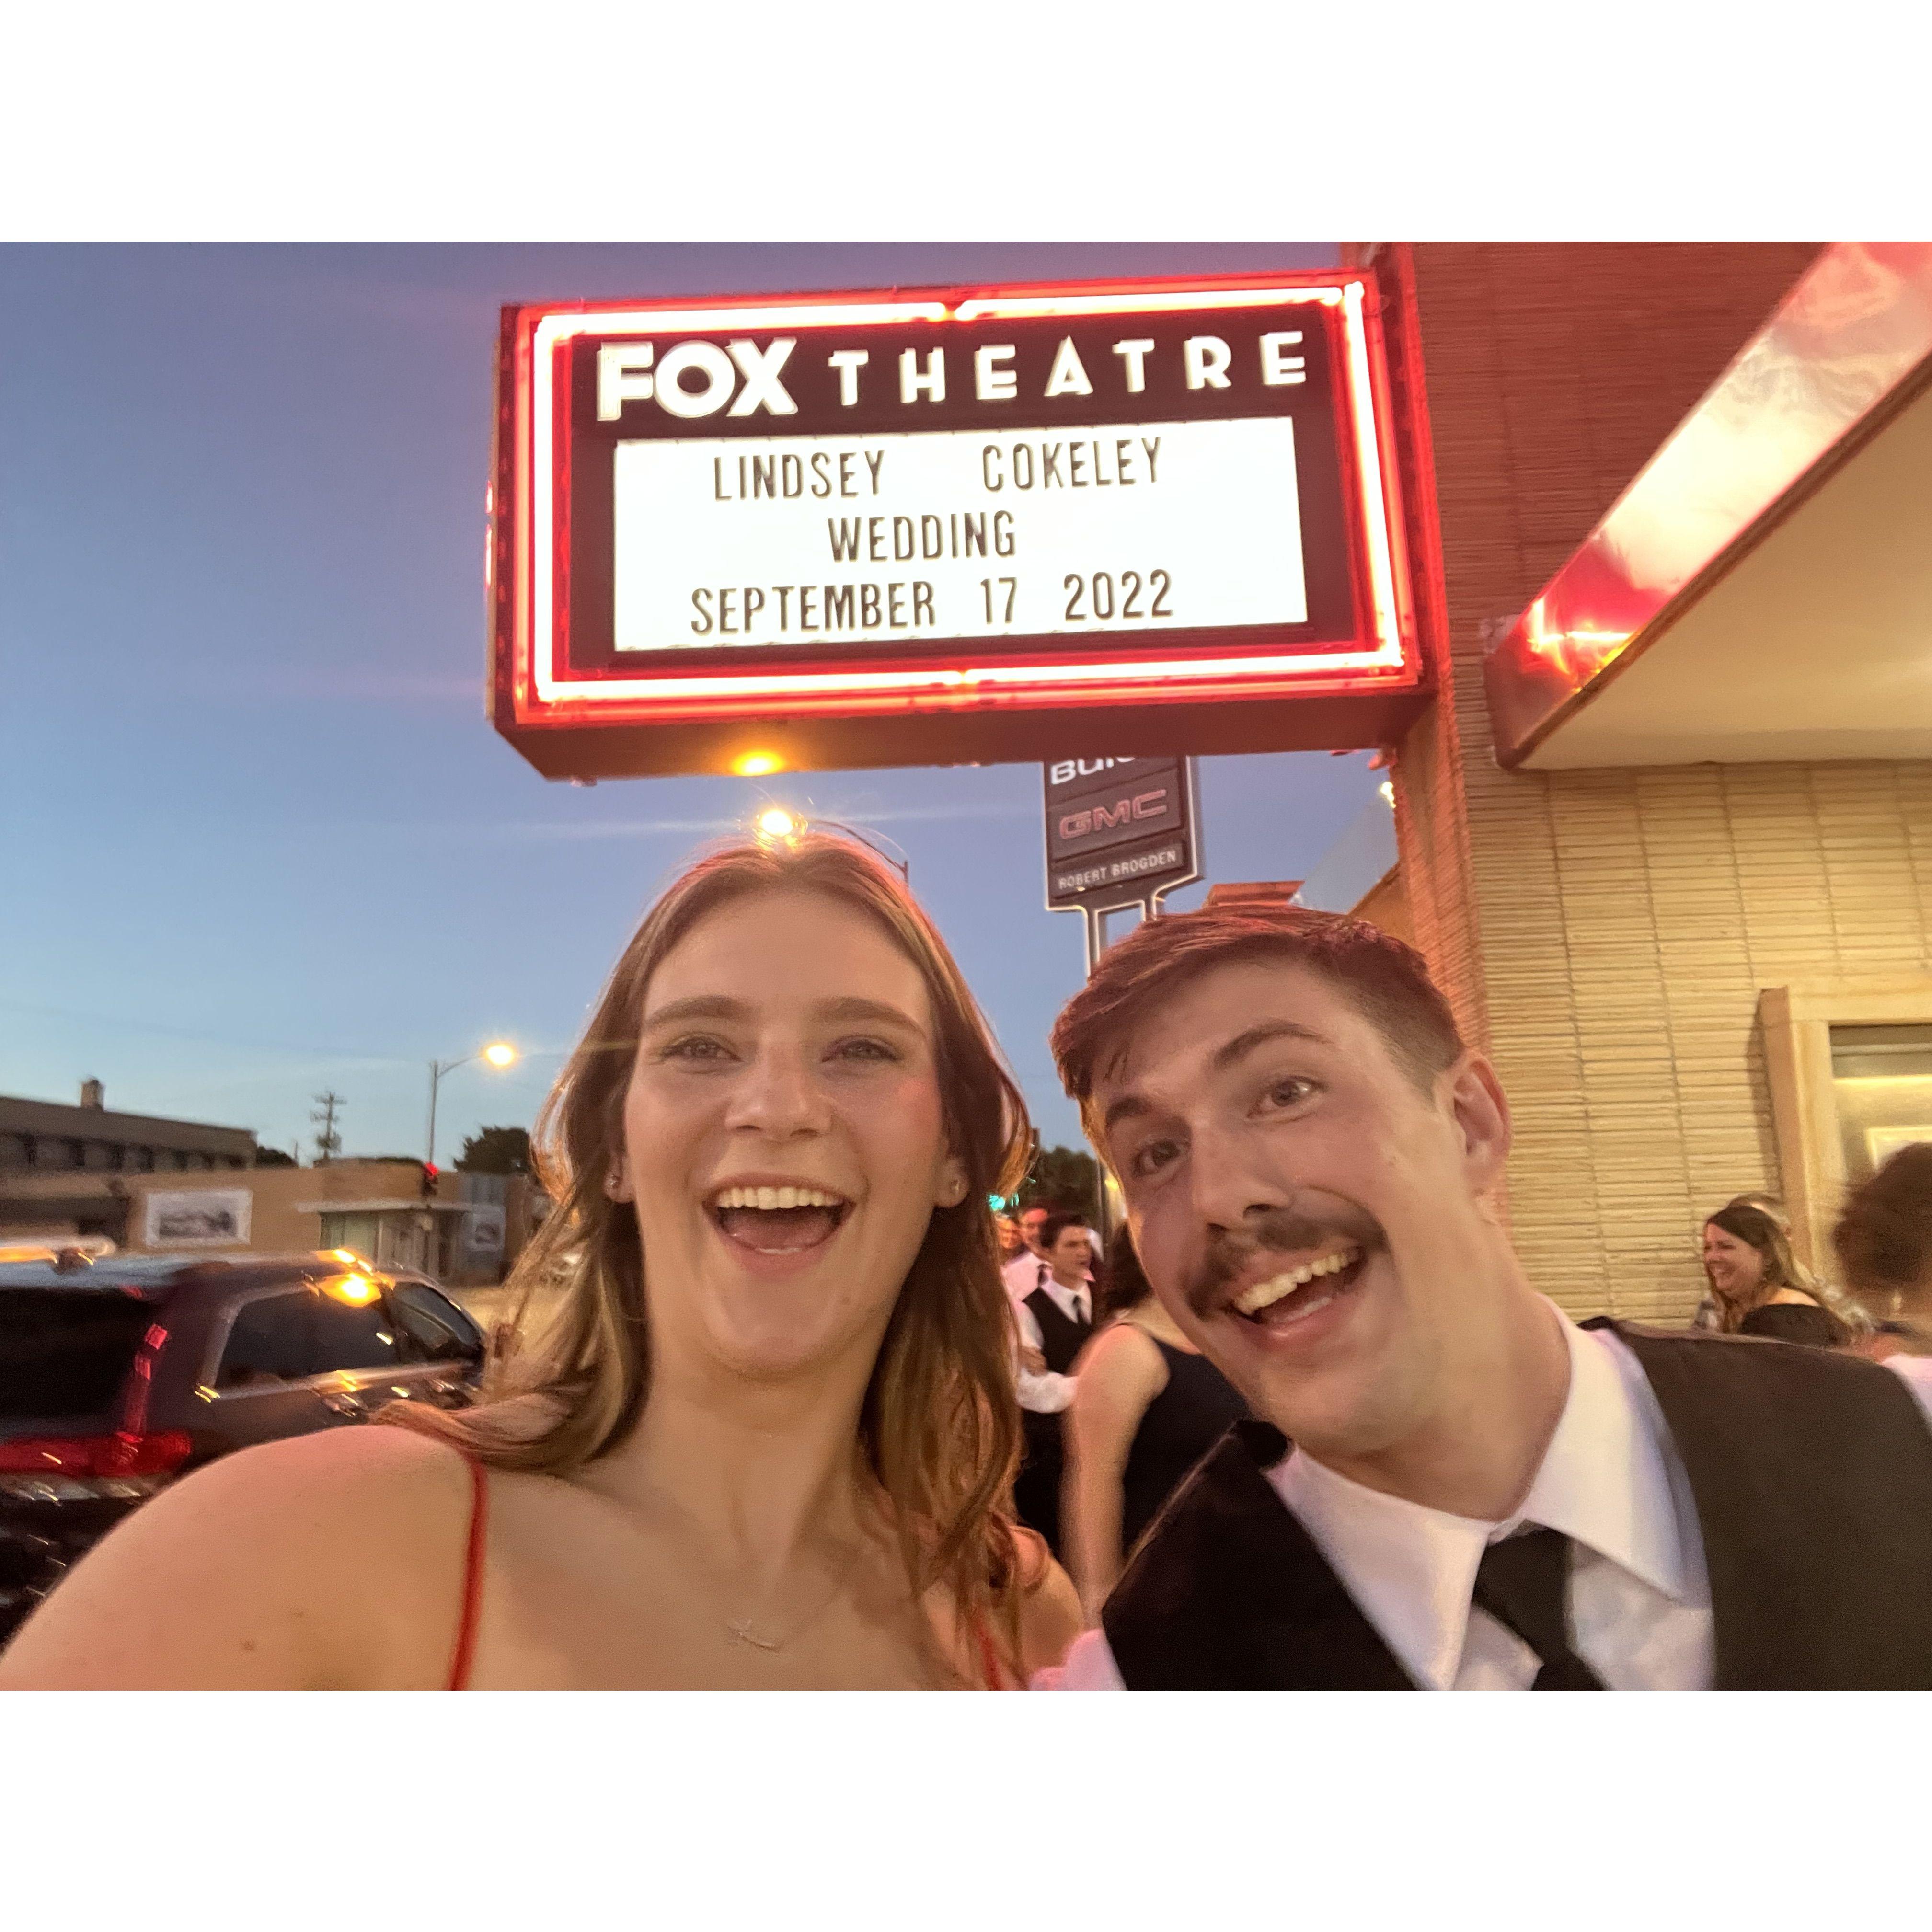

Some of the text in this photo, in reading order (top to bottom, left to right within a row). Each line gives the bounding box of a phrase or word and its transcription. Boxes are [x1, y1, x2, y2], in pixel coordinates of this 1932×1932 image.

[597, 330, 1306, 422] FOX THEATRE
[714, 437, 1163, 500] LINDSEY COKELEY
[828, 511, 1016, 563] WEDDING
[690, 569, 1174, 633] SEPTEMBER 17 2022
[1059, 789, 1167, 839] GMC
[1058, 851, 1176, 889] ROBERT BROGDEN
